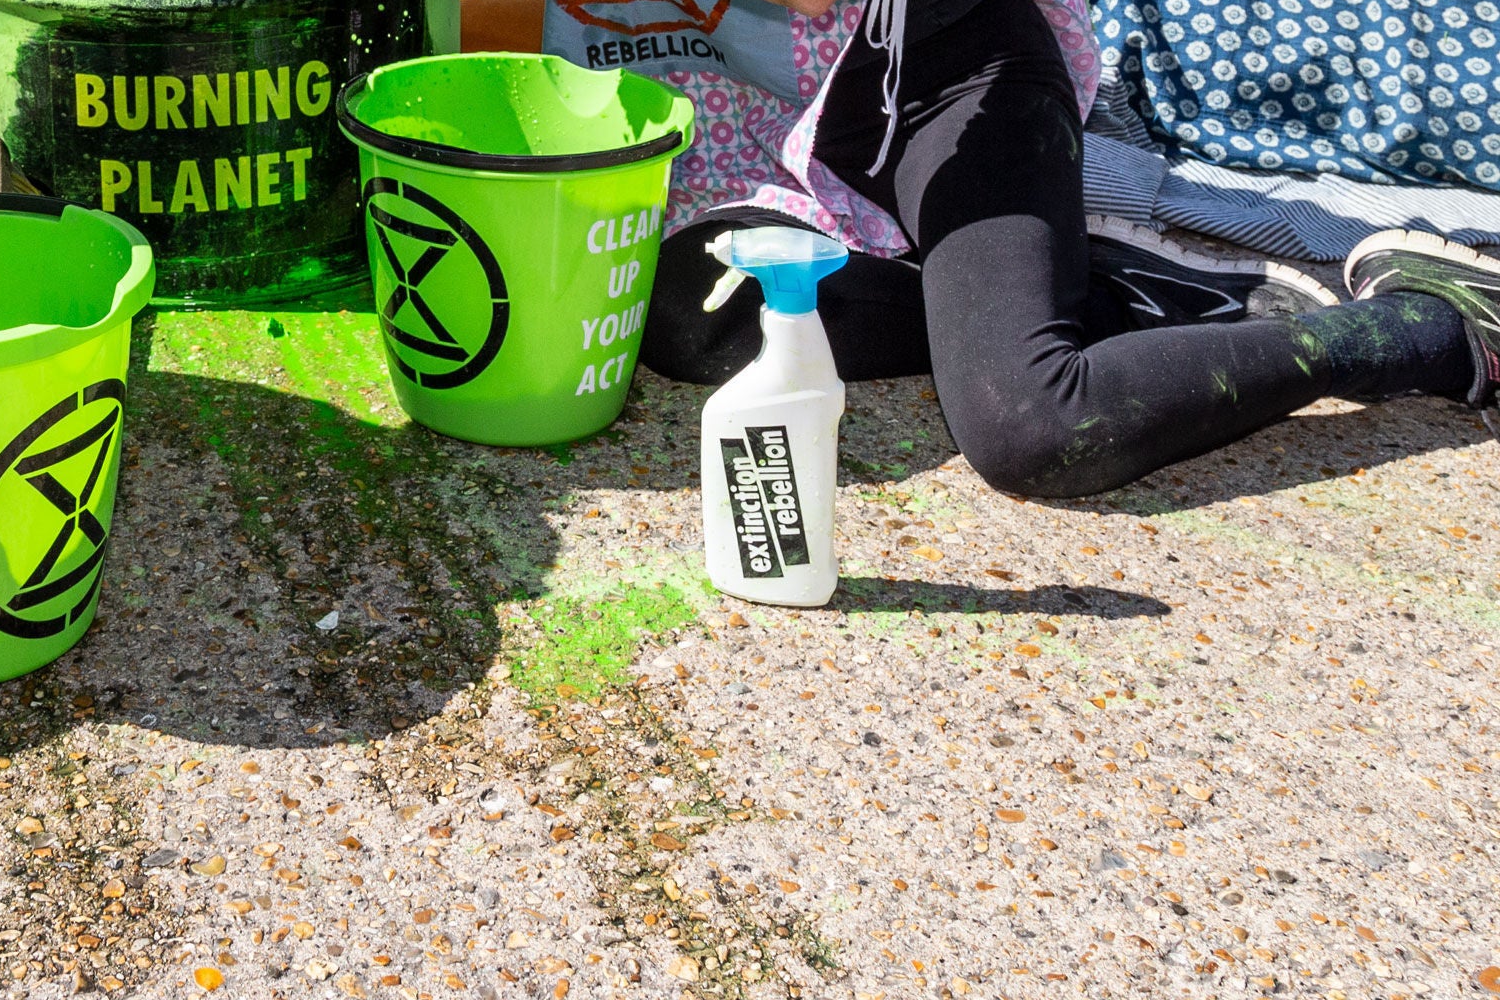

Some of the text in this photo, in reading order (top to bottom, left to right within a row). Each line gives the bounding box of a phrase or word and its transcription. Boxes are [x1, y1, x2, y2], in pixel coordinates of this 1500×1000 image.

[75, 60, 331, 130] BURNING
[100, 147, 312, 213] PLANET
[587, 204, 661, 254] CLEAN
[608, 260, 640, 298] UP
[581, 300, 644, 350] YOUR
[730, 456, 772, 574] extinction
[757, 429, 801, 536] rebellion
